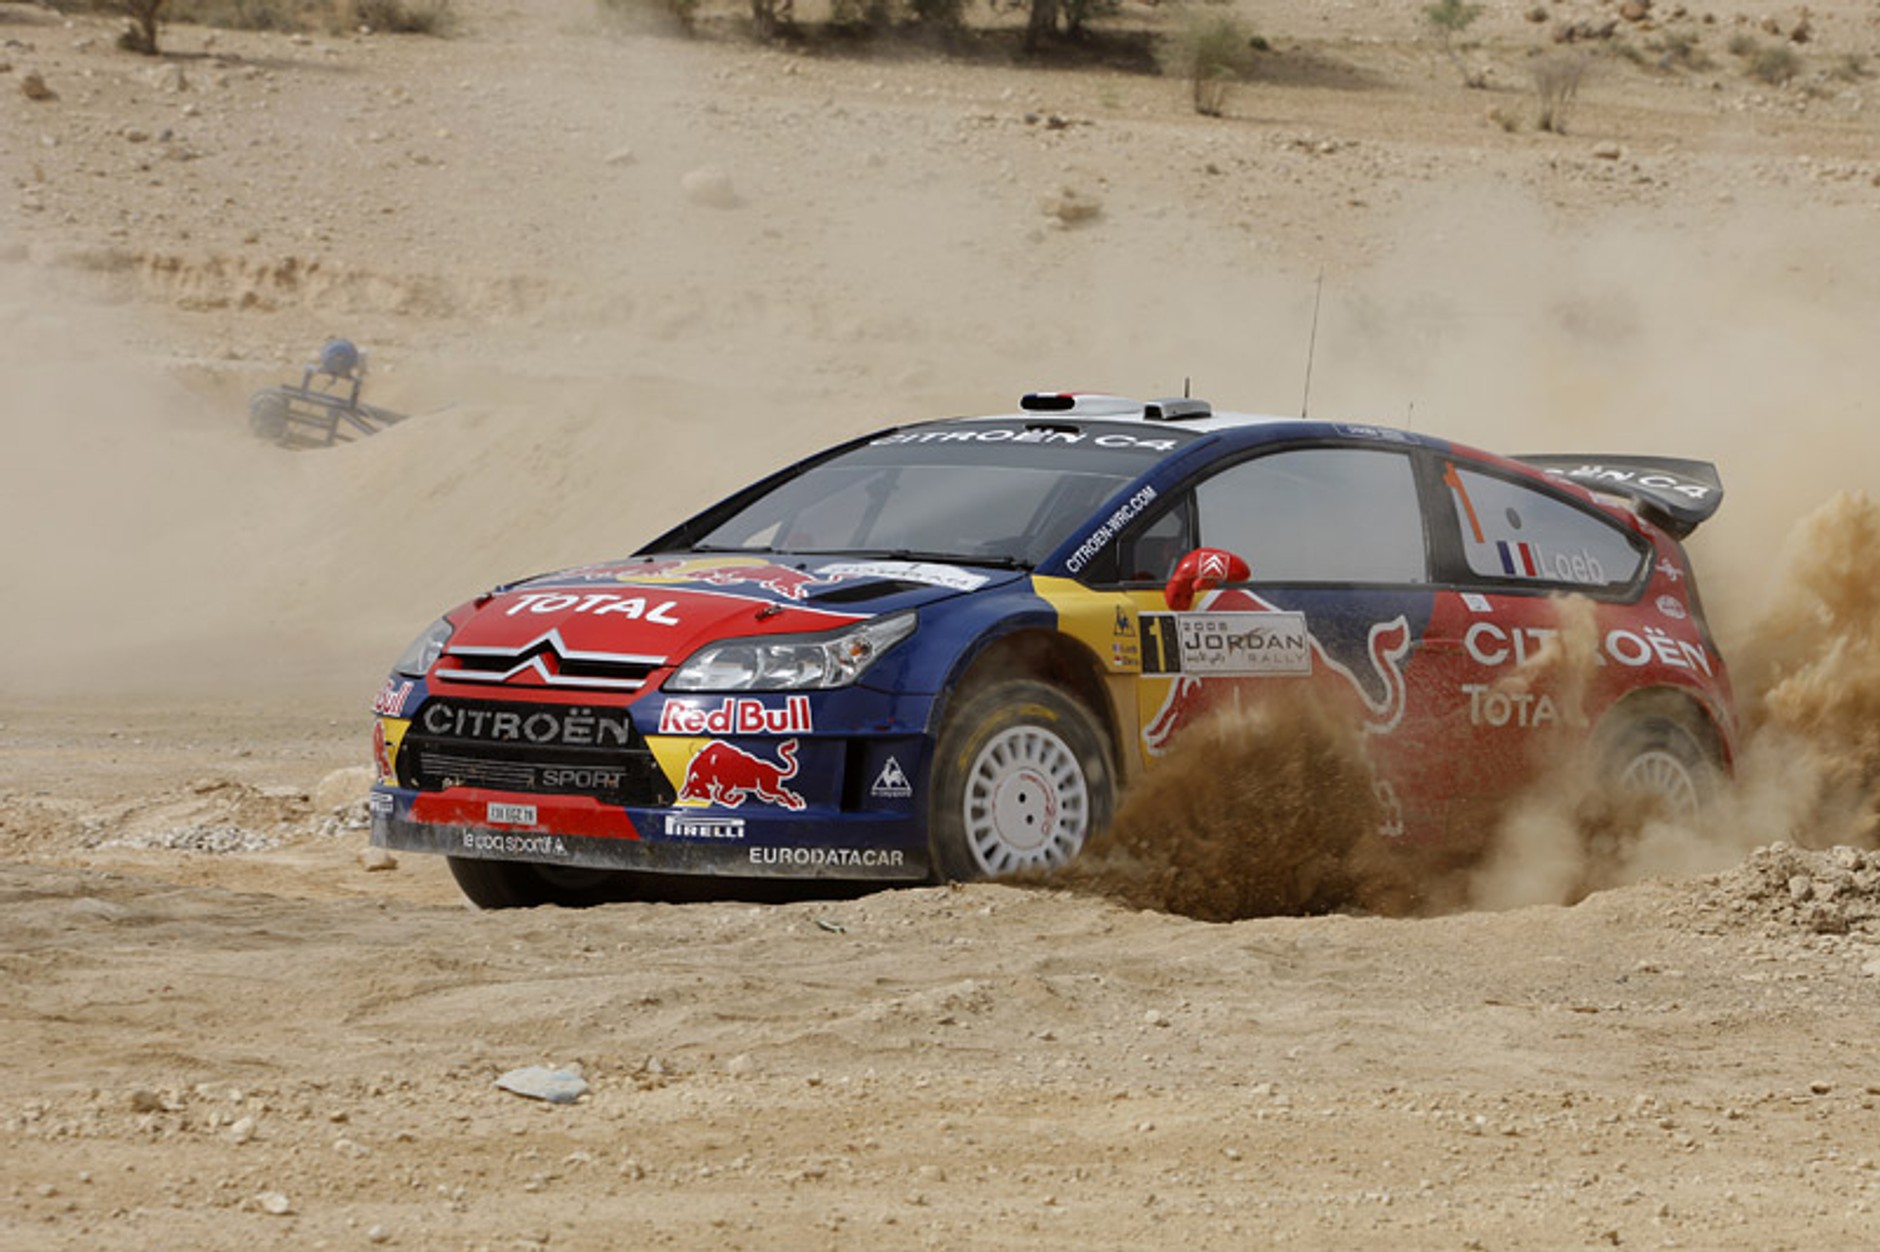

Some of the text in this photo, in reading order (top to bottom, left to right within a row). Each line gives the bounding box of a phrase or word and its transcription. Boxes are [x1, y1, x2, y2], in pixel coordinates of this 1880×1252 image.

[1095, 433, 1178, 450] C4
[1443, 461, 1485, 543] 1
[1639, 475, 1708, 499] C4
[1066, 485, 1158, 574] CITROEN-WRC.COM
[1534, 542, 1607, 586] Loeb
[506, 591, 680, 626] TOTAL
[1149, 616, 1167, 673] 1
[1184, 632, 1303, 650] JORDAN
[1248, 653, 1304, 664] RALLY
[1464, 615, 1713, 678] CITOËN
[423, 703, 630, 745] CITROËN
[659, 695, 813, 734] Red Bull
[1462, 683, 1588, 728] TOTA
[543, 769, 627, 789] SPORT
[665, 815, 745, 838] PIRELLI
[749, 847, 904, 867] EURODATACAR
